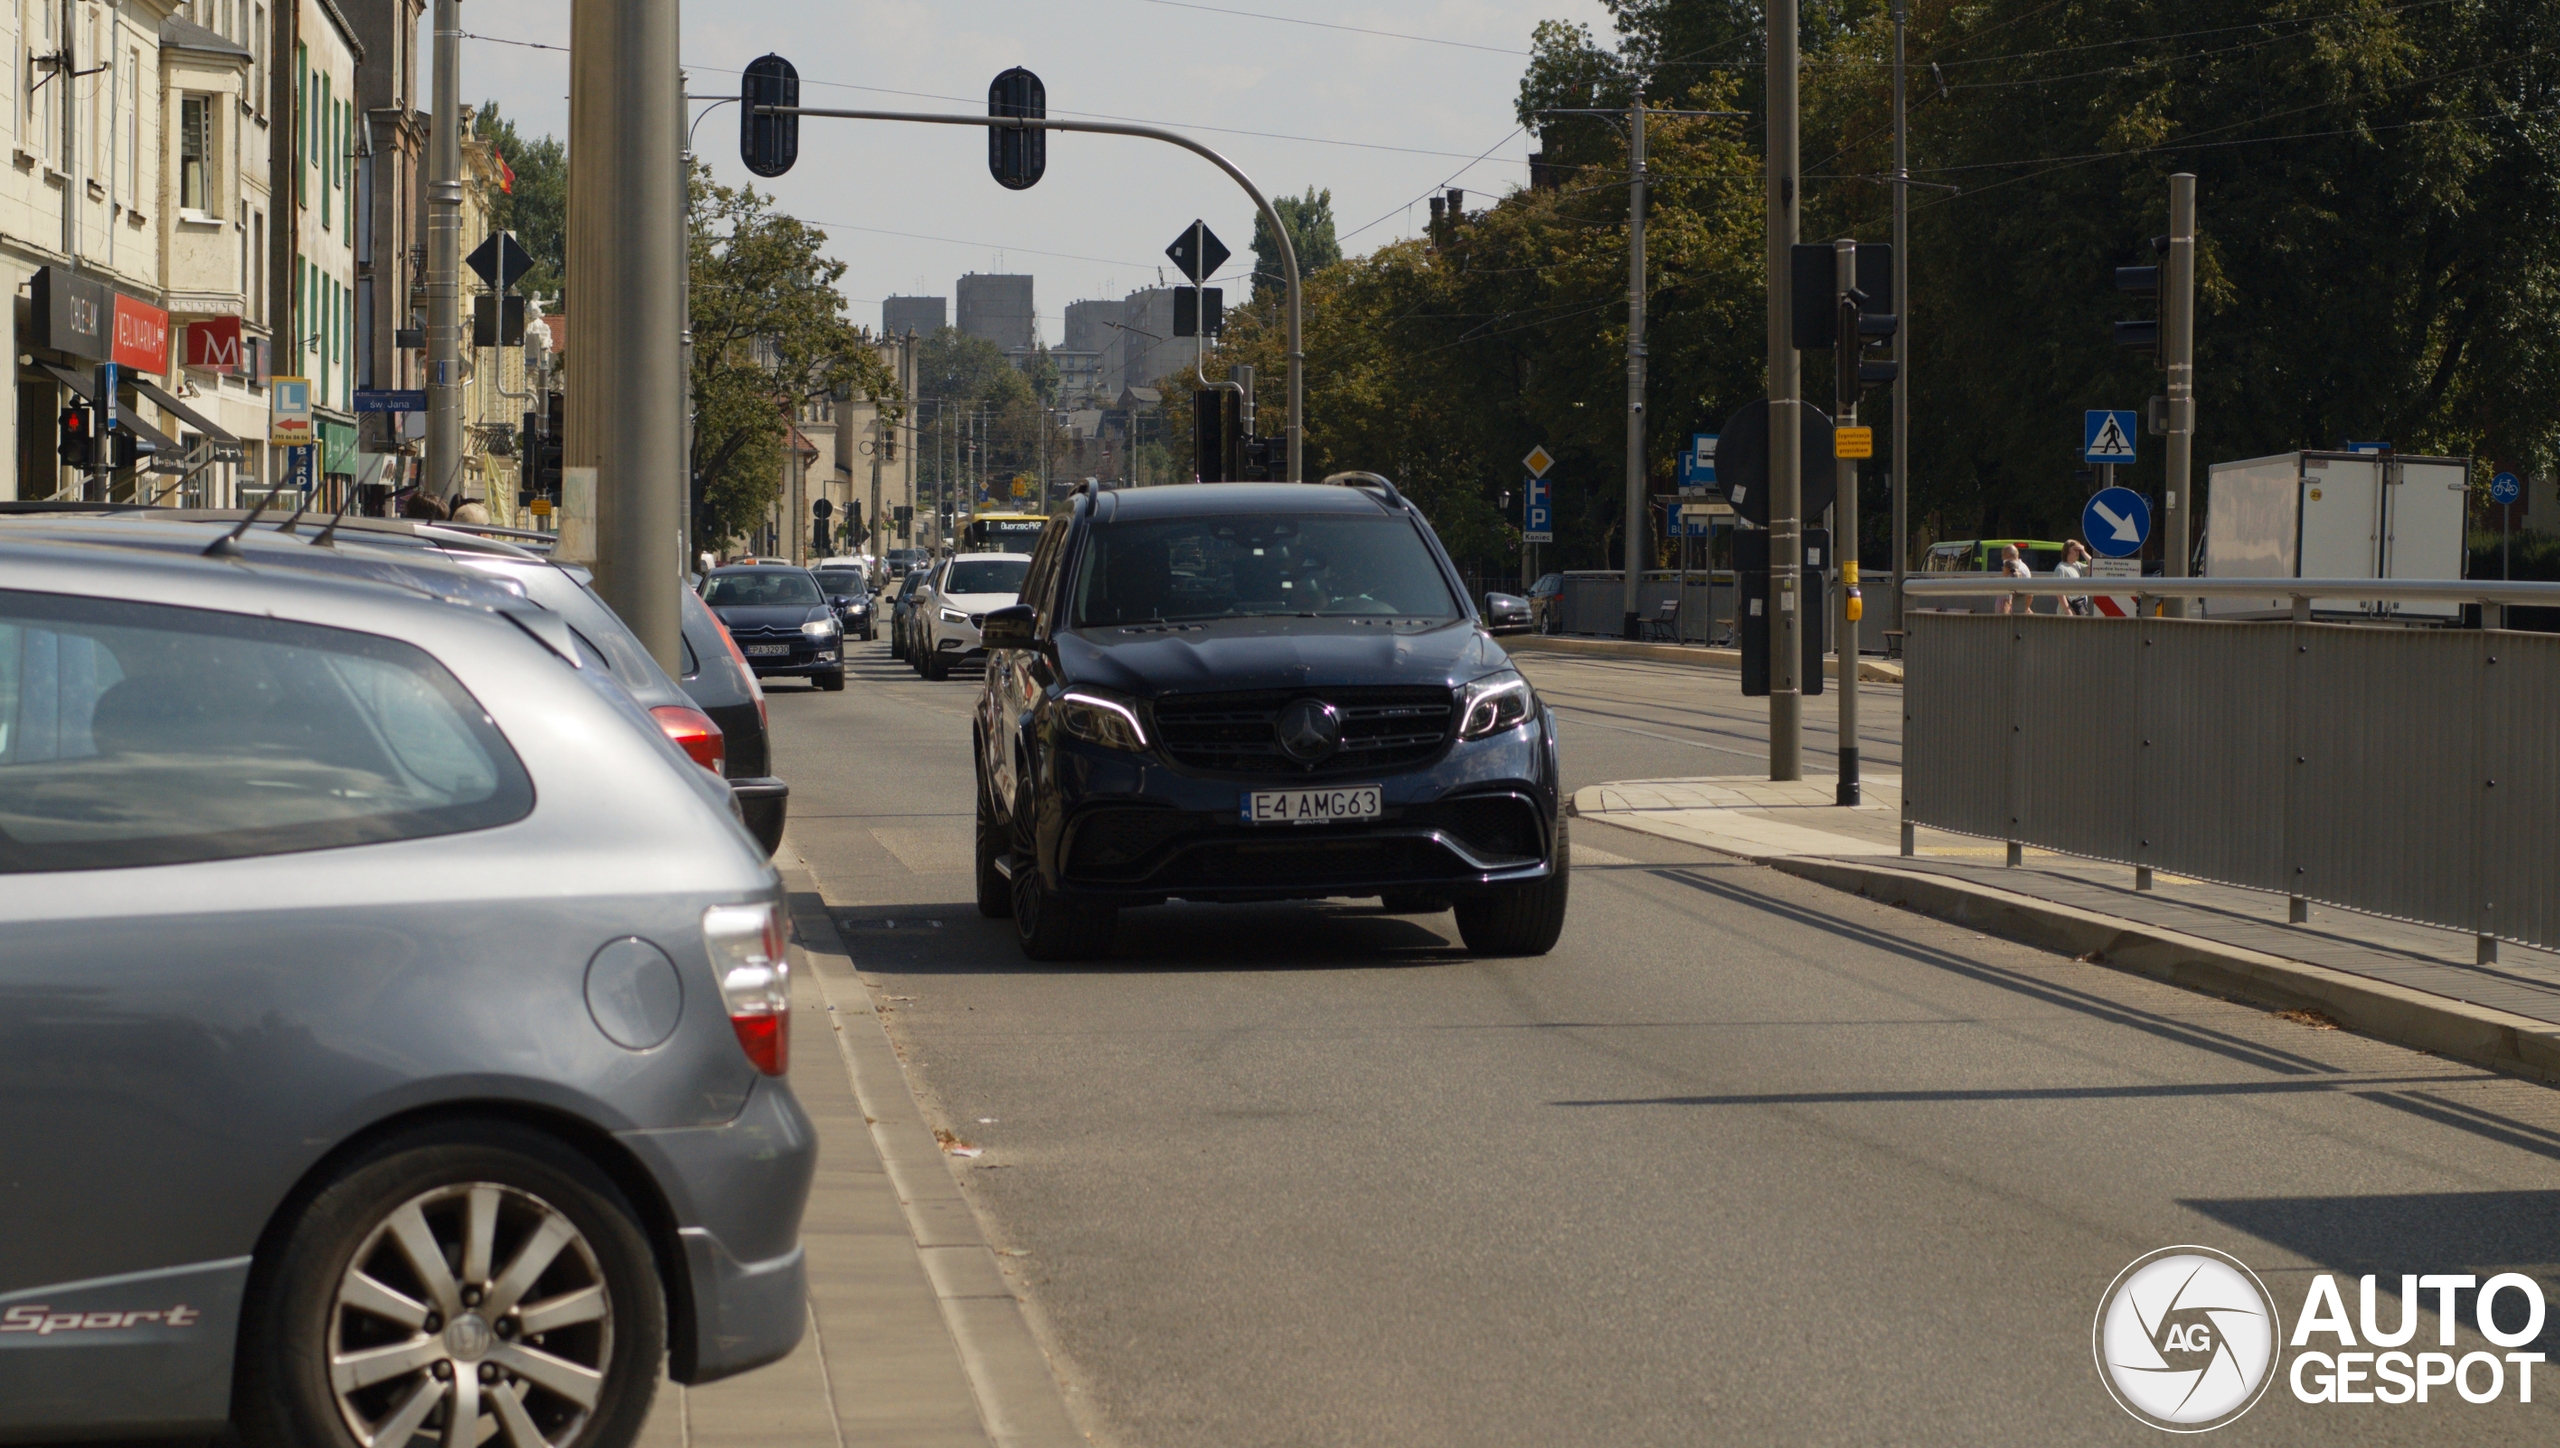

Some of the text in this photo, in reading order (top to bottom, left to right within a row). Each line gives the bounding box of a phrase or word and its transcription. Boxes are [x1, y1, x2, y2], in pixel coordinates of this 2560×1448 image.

[201, 329, 239, 366] M
[281, 385, 301, 410] L
[387, 400, 410, 409] Jana
[985, 521, 1042, 531] T Dworzec PKP
[1531, 508, 1547, 529] P
[1525, 533, 1551, 541] Koniec
[748, 645, 789, 654] EPA 32930
[1241, 790, 1377, 819] PL E4 AMG63
[0, 1304, 200, 1335] Sport
